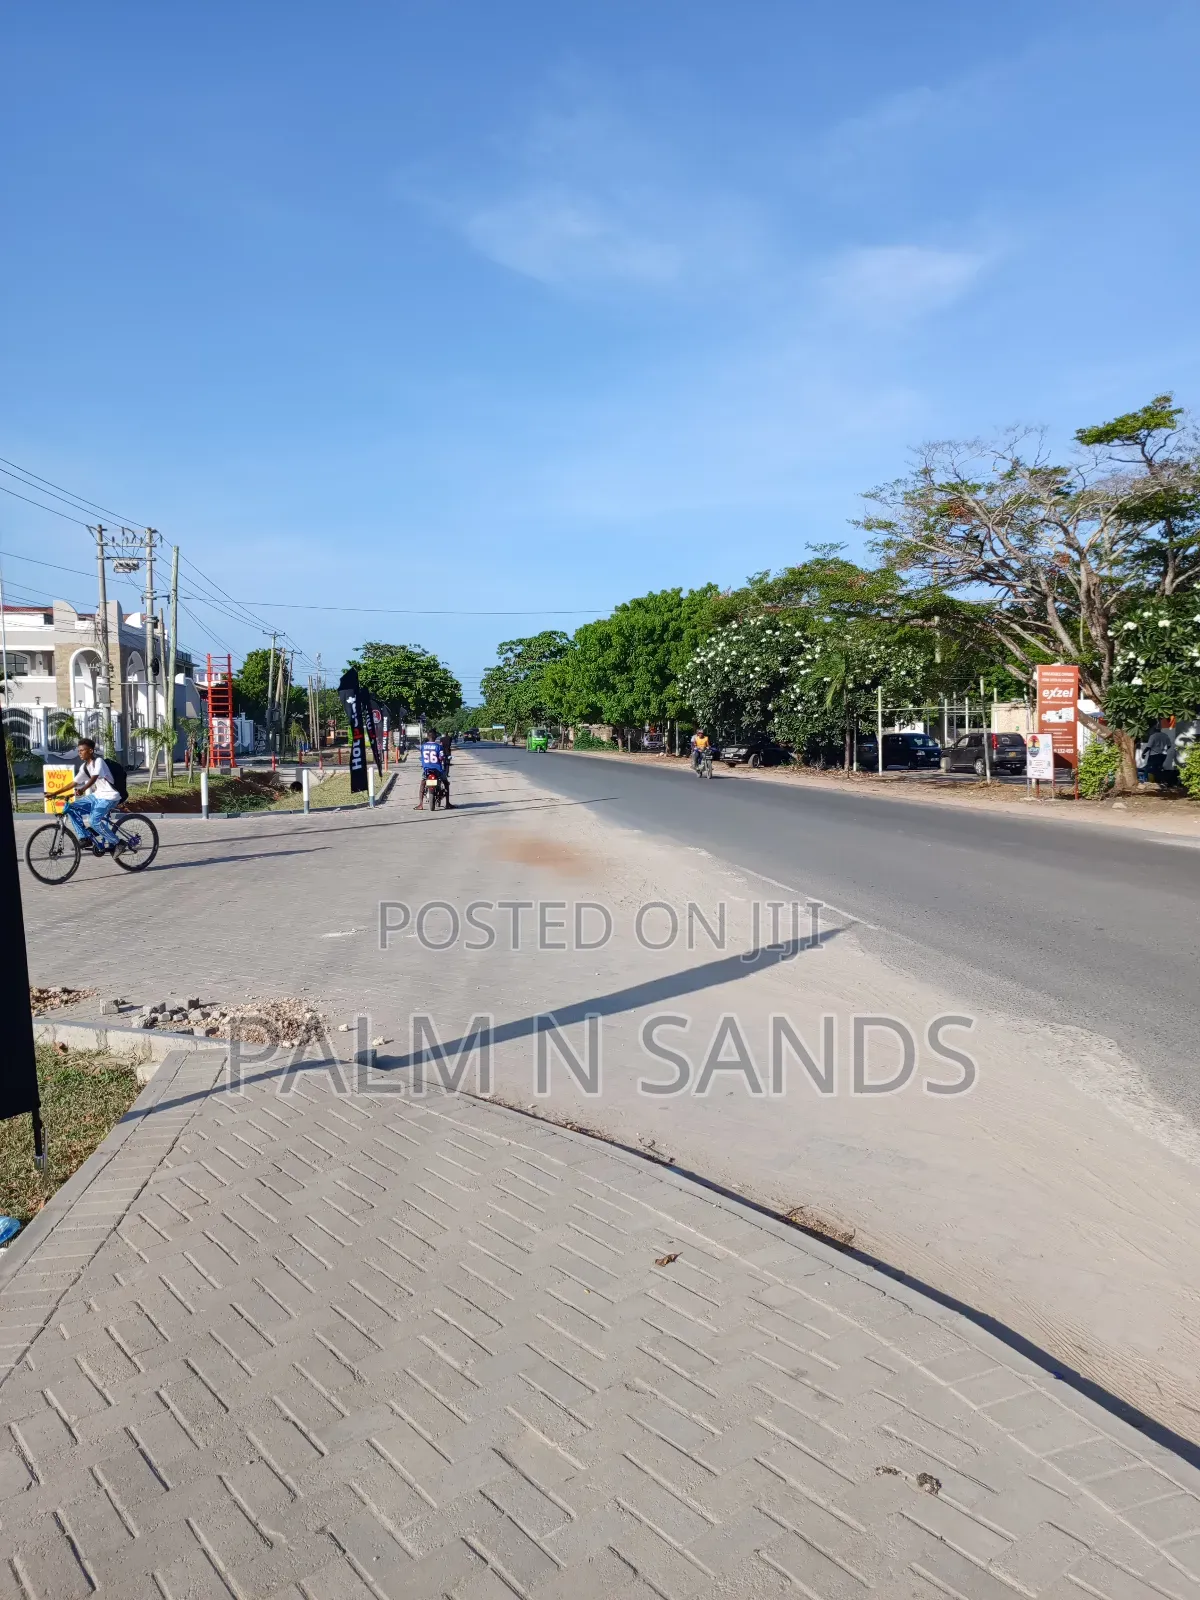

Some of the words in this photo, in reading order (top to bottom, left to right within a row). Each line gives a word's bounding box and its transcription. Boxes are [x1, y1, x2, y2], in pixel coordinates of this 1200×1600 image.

[1042, 687, 1074, 699] exzel
[423, 751, 437, 763] 56
[48, 771, 66, 781] Way
